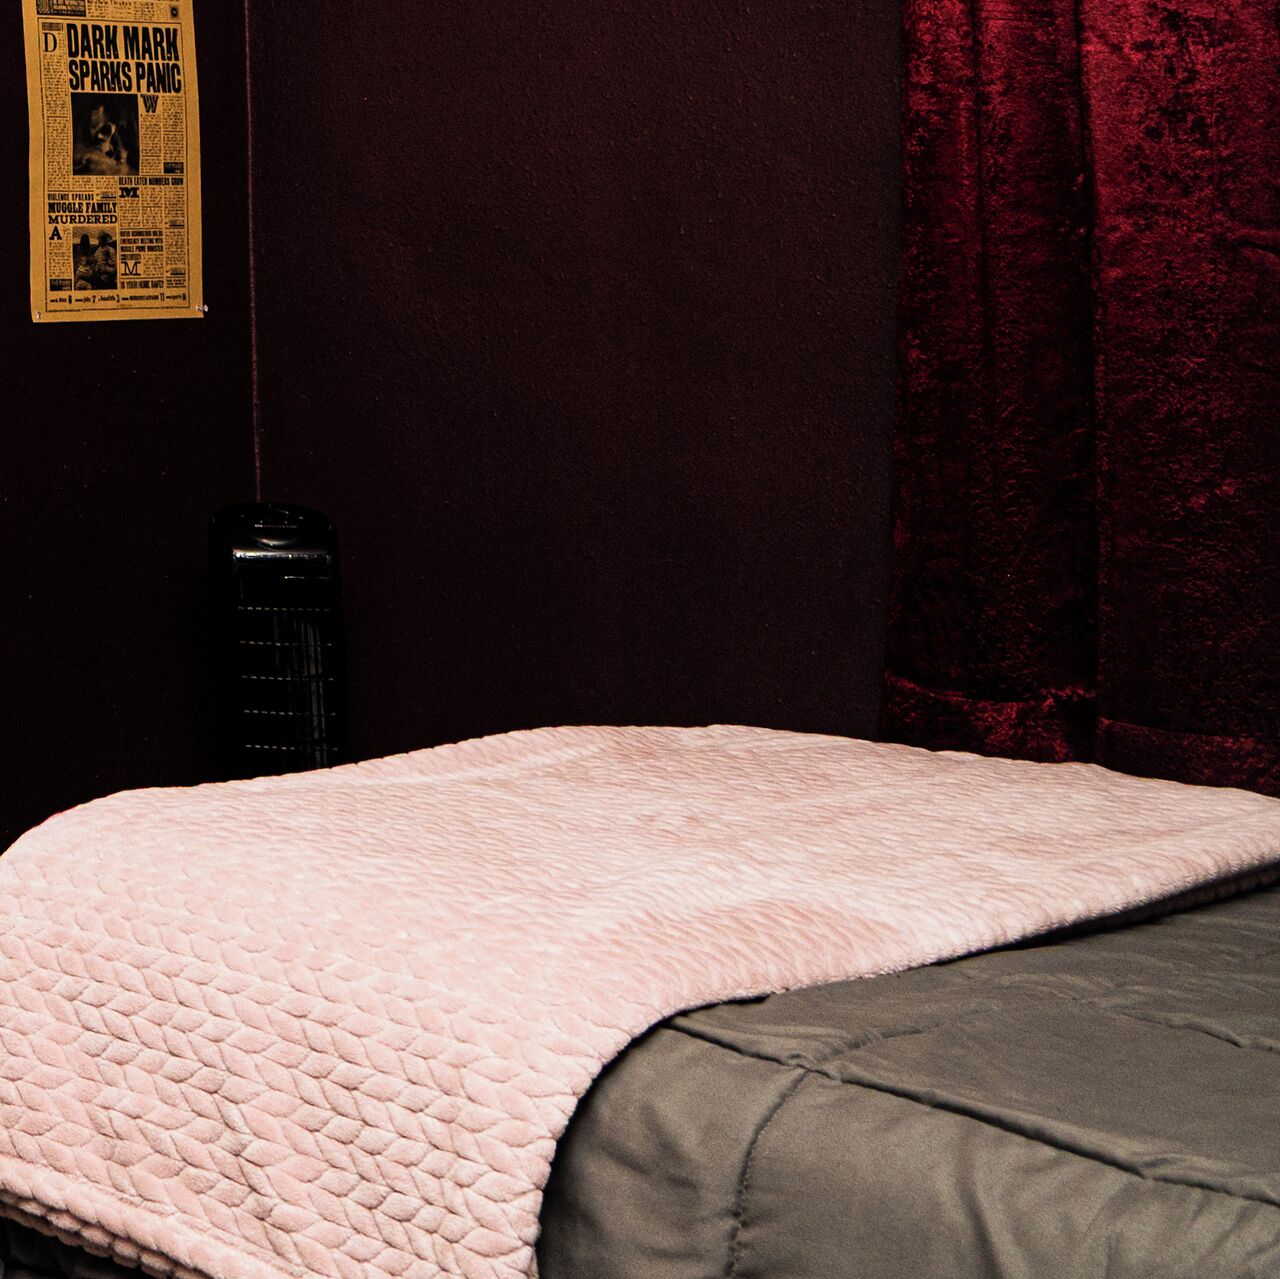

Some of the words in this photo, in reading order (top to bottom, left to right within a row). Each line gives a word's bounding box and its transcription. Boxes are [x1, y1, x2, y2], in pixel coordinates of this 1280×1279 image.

[66, 23, 120, 60] DARK
[122, 25, 180, 62] MARK
[68, 59, 133, 93] SPARKS
[135, 61, 182, 94] PANIC
[47, 201, 84, 214] MUGGLE
[85, 201, 118, 214] FAMILY
[47, 214, 118, 225] MURDERED
